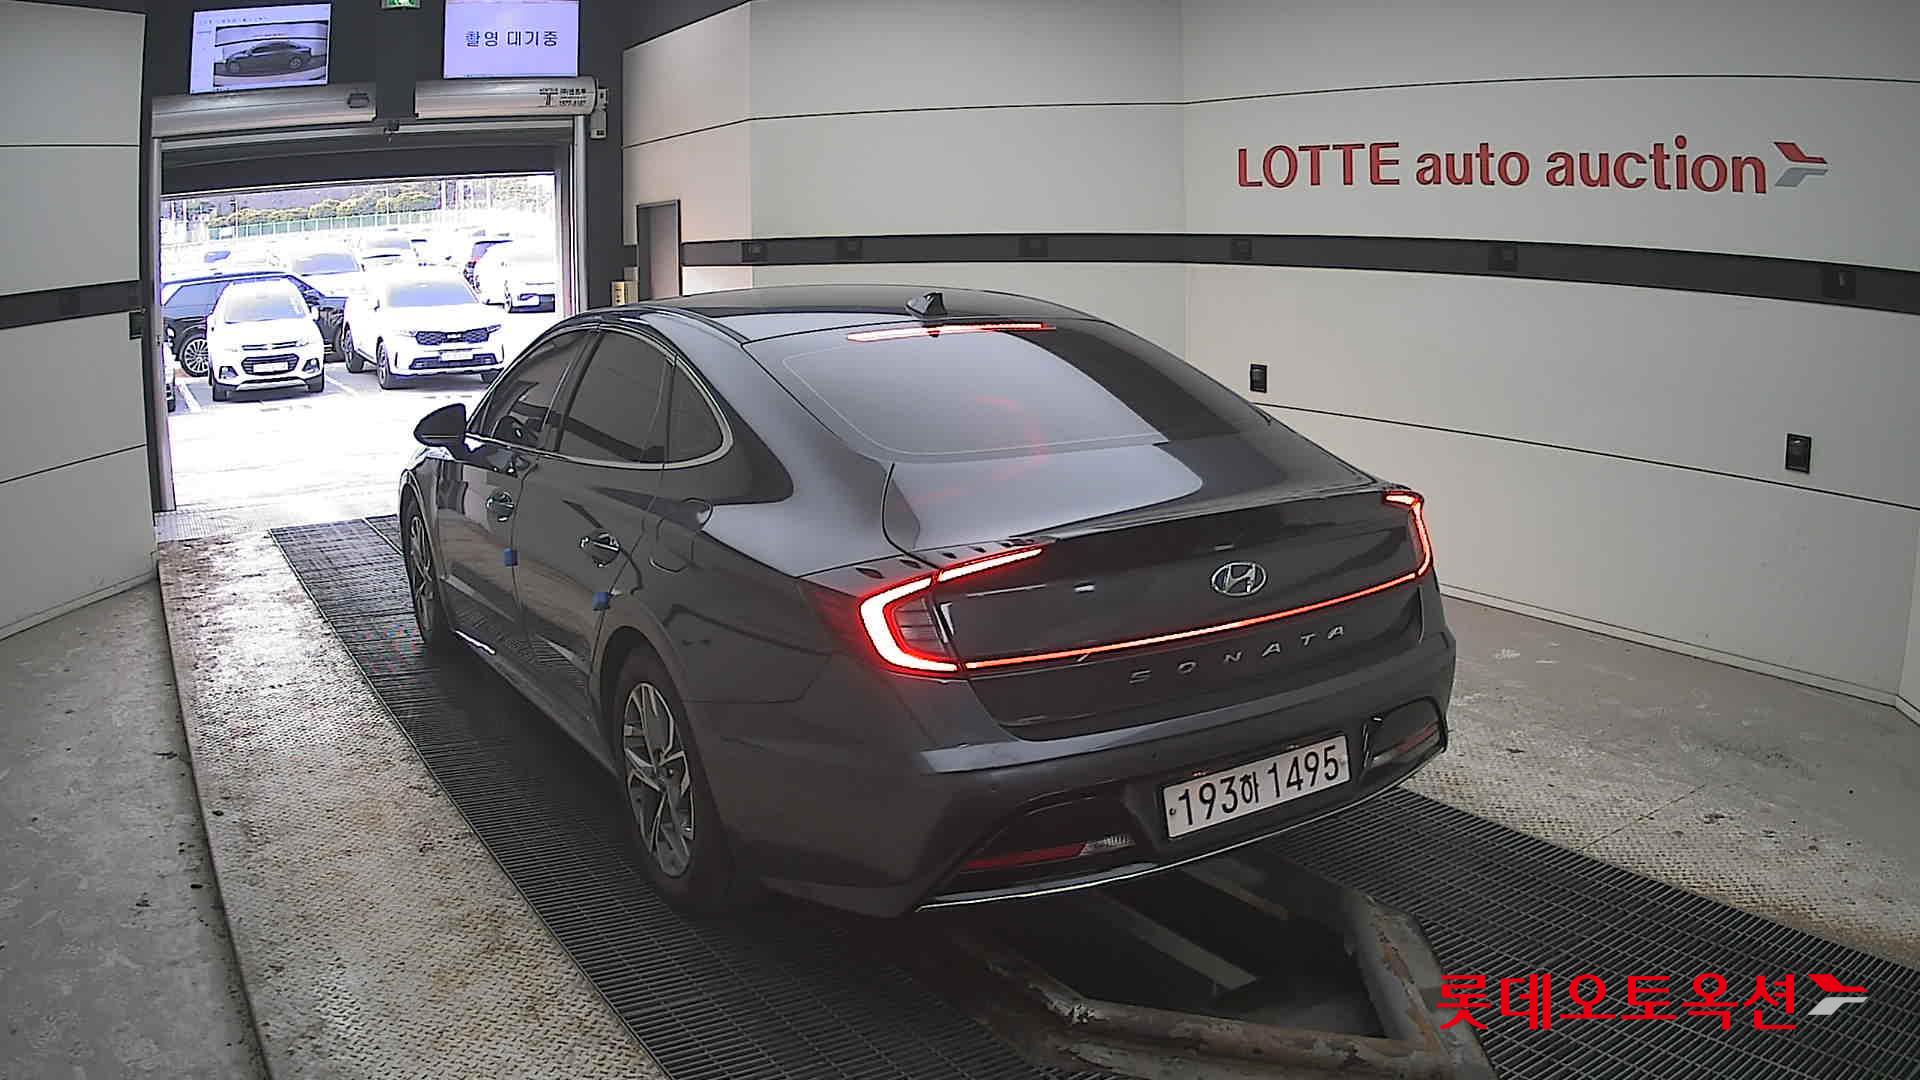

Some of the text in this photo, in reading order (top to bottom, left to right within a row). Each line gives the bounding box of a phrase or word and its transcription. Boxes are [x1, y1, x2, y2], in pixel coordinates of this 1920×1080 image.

[507, 31, 559, 47] 대기중
[1237, 135, 1767, 194] LOTTE auto auction
[1128, 625, 1345, 684] SONATA
[1178, 745, 1340, 826] 193하 1495
